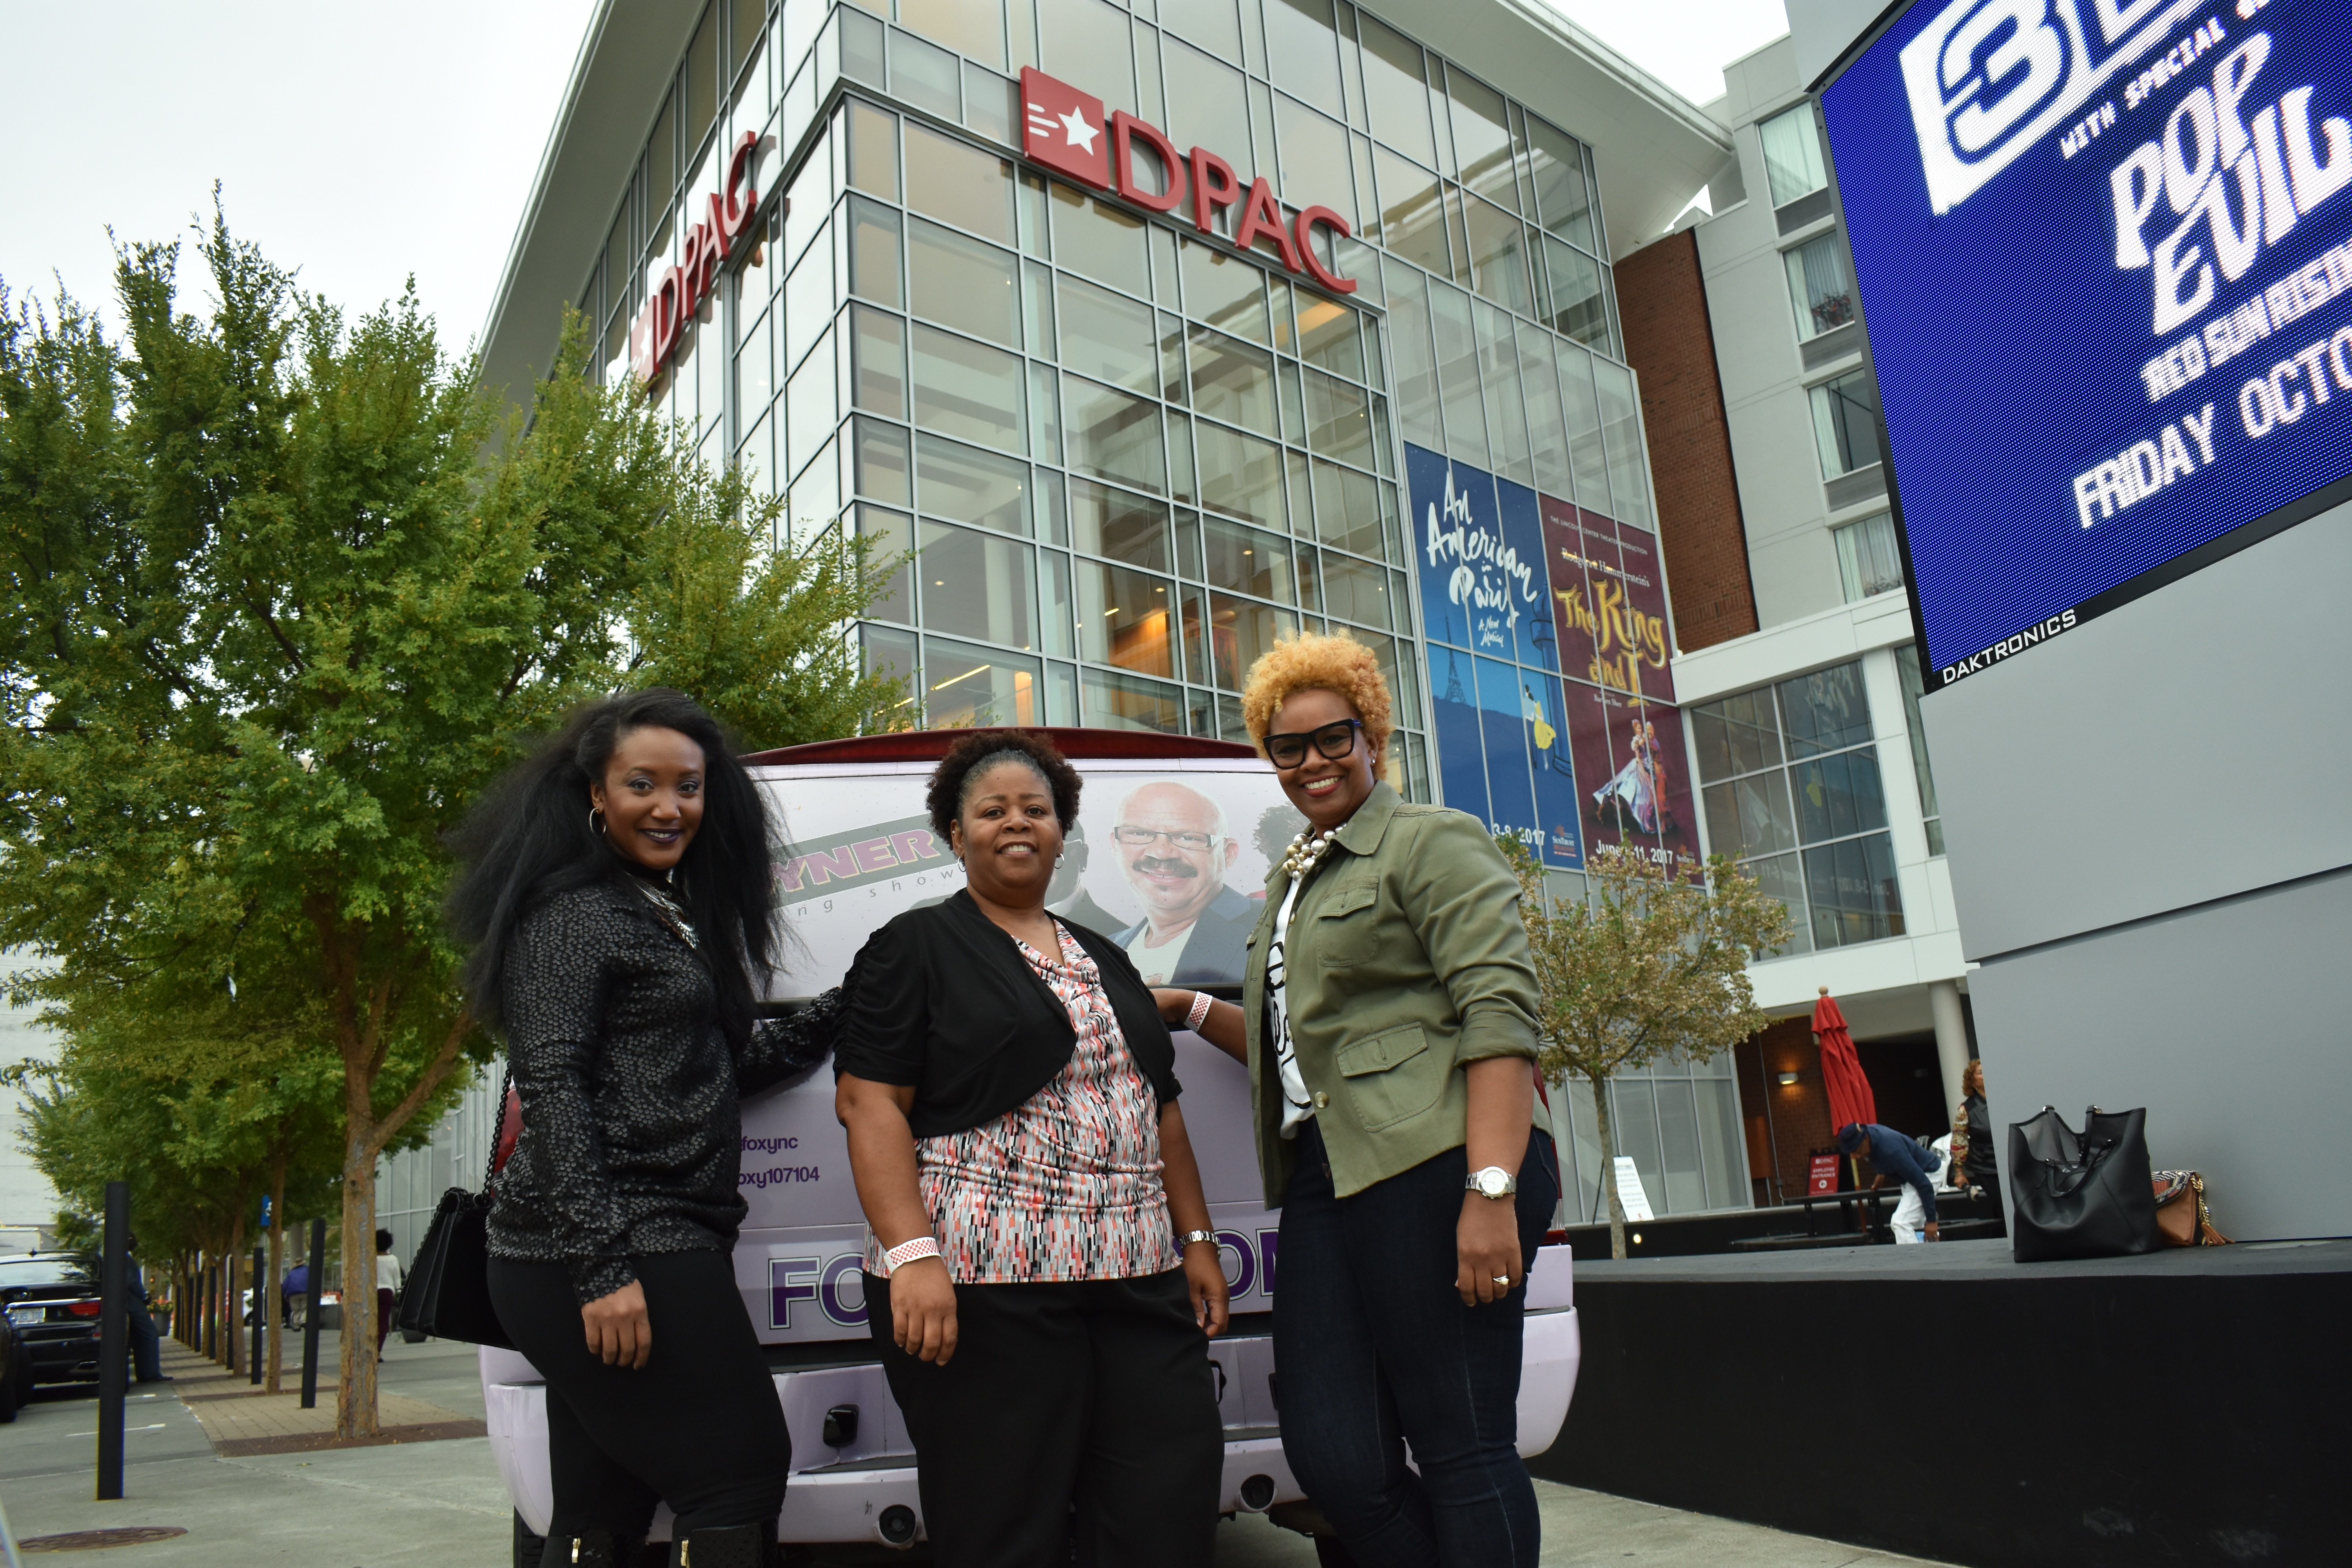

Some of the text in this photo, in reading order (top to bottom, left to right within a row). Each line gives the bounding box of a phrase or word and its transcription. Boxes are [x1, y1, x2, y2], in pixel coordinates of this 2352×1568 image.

[2060, 17, 2226, 157] WITH SPECIAL
[2110, 32, 2272, 270] POP
[1112, 109, 1357, 295] DPAC
[2154, 85, 2352, 336] EVIL
[657, 131, 756, 367] DPAC
[2140, 334, 2208, 403] RED
[2203, 294, 2271, 368] SUN
[2073, 402, 2215, 529] FRIDAY
[1443, 472, 1472, 524] An
[1550, 515, 1559, 524] THE
[1582, 527, 1599, 538] CENTER
[1426, 501, 1537, 603] American
[1481, 560, 1492, 572] in
[1449, 566, 1520, 628] Paris
[1478, 615, 1500, 632] A New
[1554, 583, 1600, 637] The
[1591, 579, 1666, 670] King
[1589, 652, 1627, 690] and
[1943, 608, 2076, 684] DAKTRONICS
[1620, 648, 1650, 708] I
[771, 829, 942, 893] YNER
[1518, 827, 1545, 846] 2017
[1595, 839, 1621, 857] June
[1650, 848, 1673, 865] 2017
[870, 868, 953, 897] show
[739, 1167, 820, 1189] oxy107104
